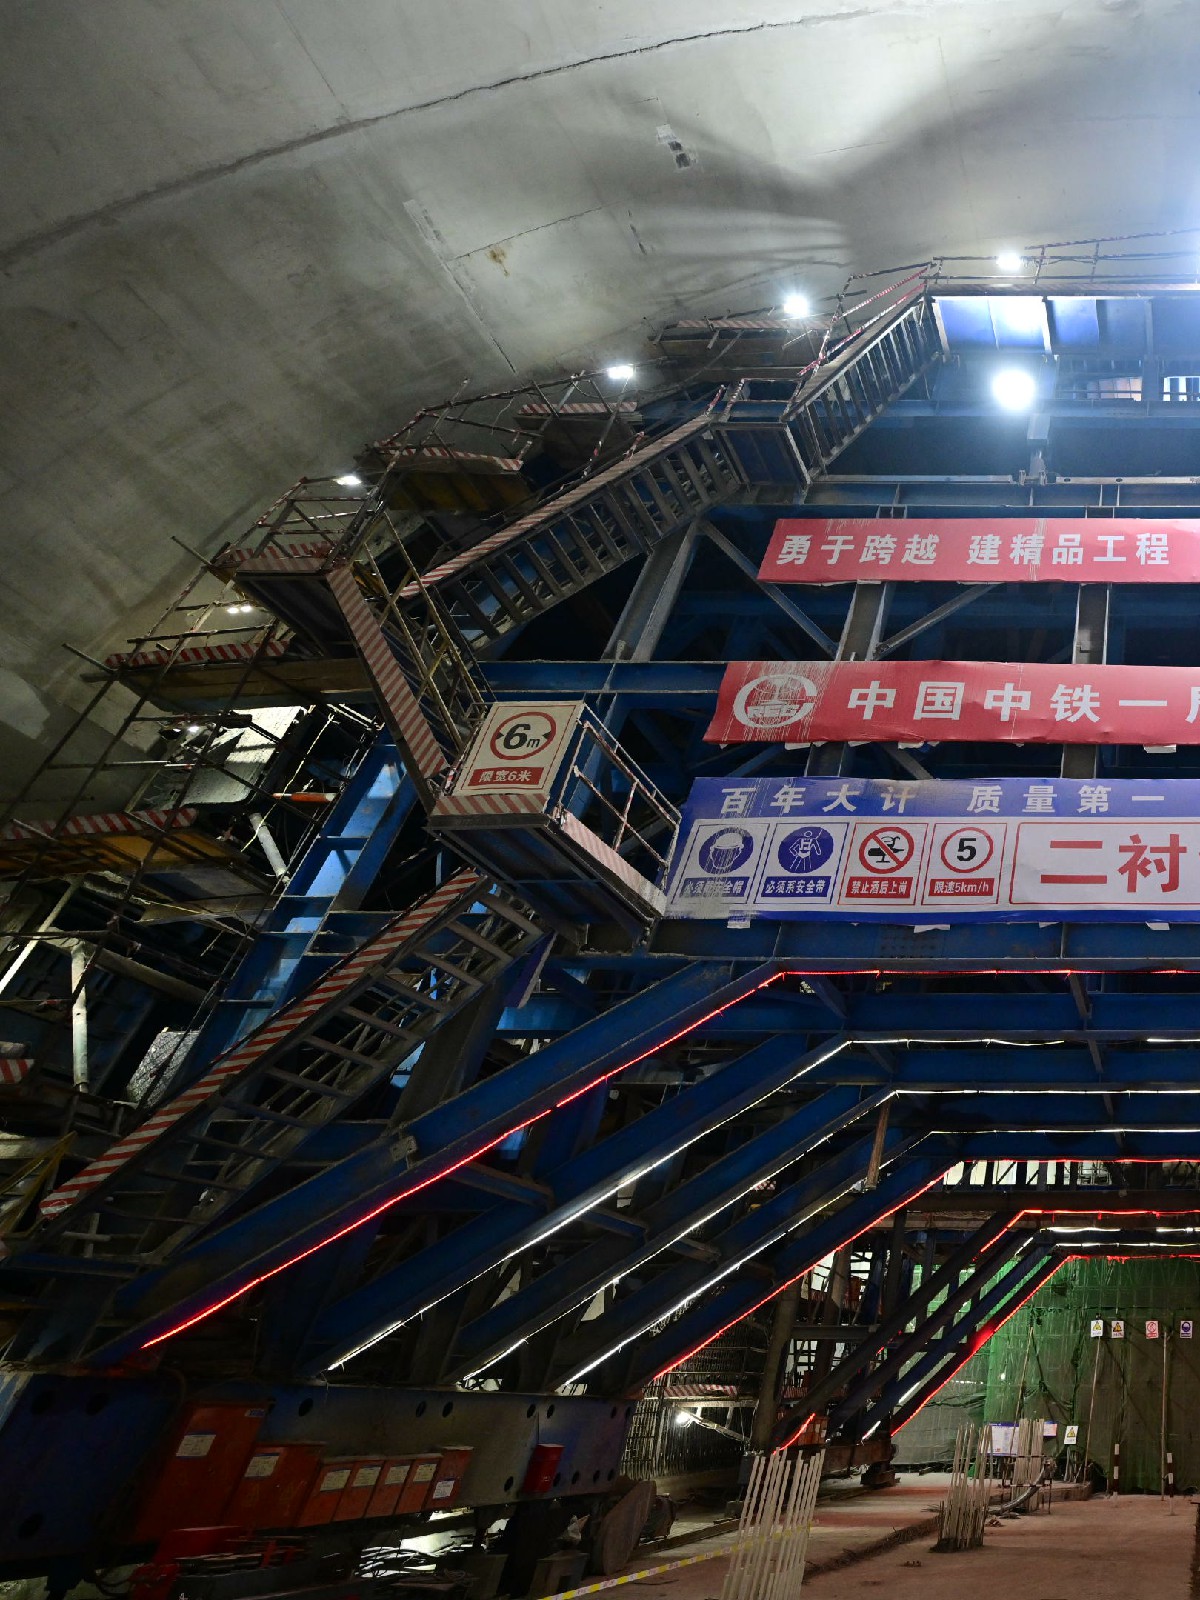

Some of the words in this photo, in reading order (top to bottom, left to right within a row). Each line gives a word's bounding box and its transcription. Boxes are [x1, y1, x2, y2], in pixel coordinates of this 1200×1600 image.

[776, 533, 938, 566] 勇于跨越
[968, 532, 1171, 566] 建精品工程
[479, 770, 532, 783] 限宽6米
[720, 785, 917, 815] 百年大计
[966, 784, 1166, 814] 质量第一
[956, 838, 977, 862] 5
[765, 879, 826, 894] 必须系安全带
[851, 880, 908, 895] 禁止酒后上岗
[934, 881, 989, 894] 限速5km/h
